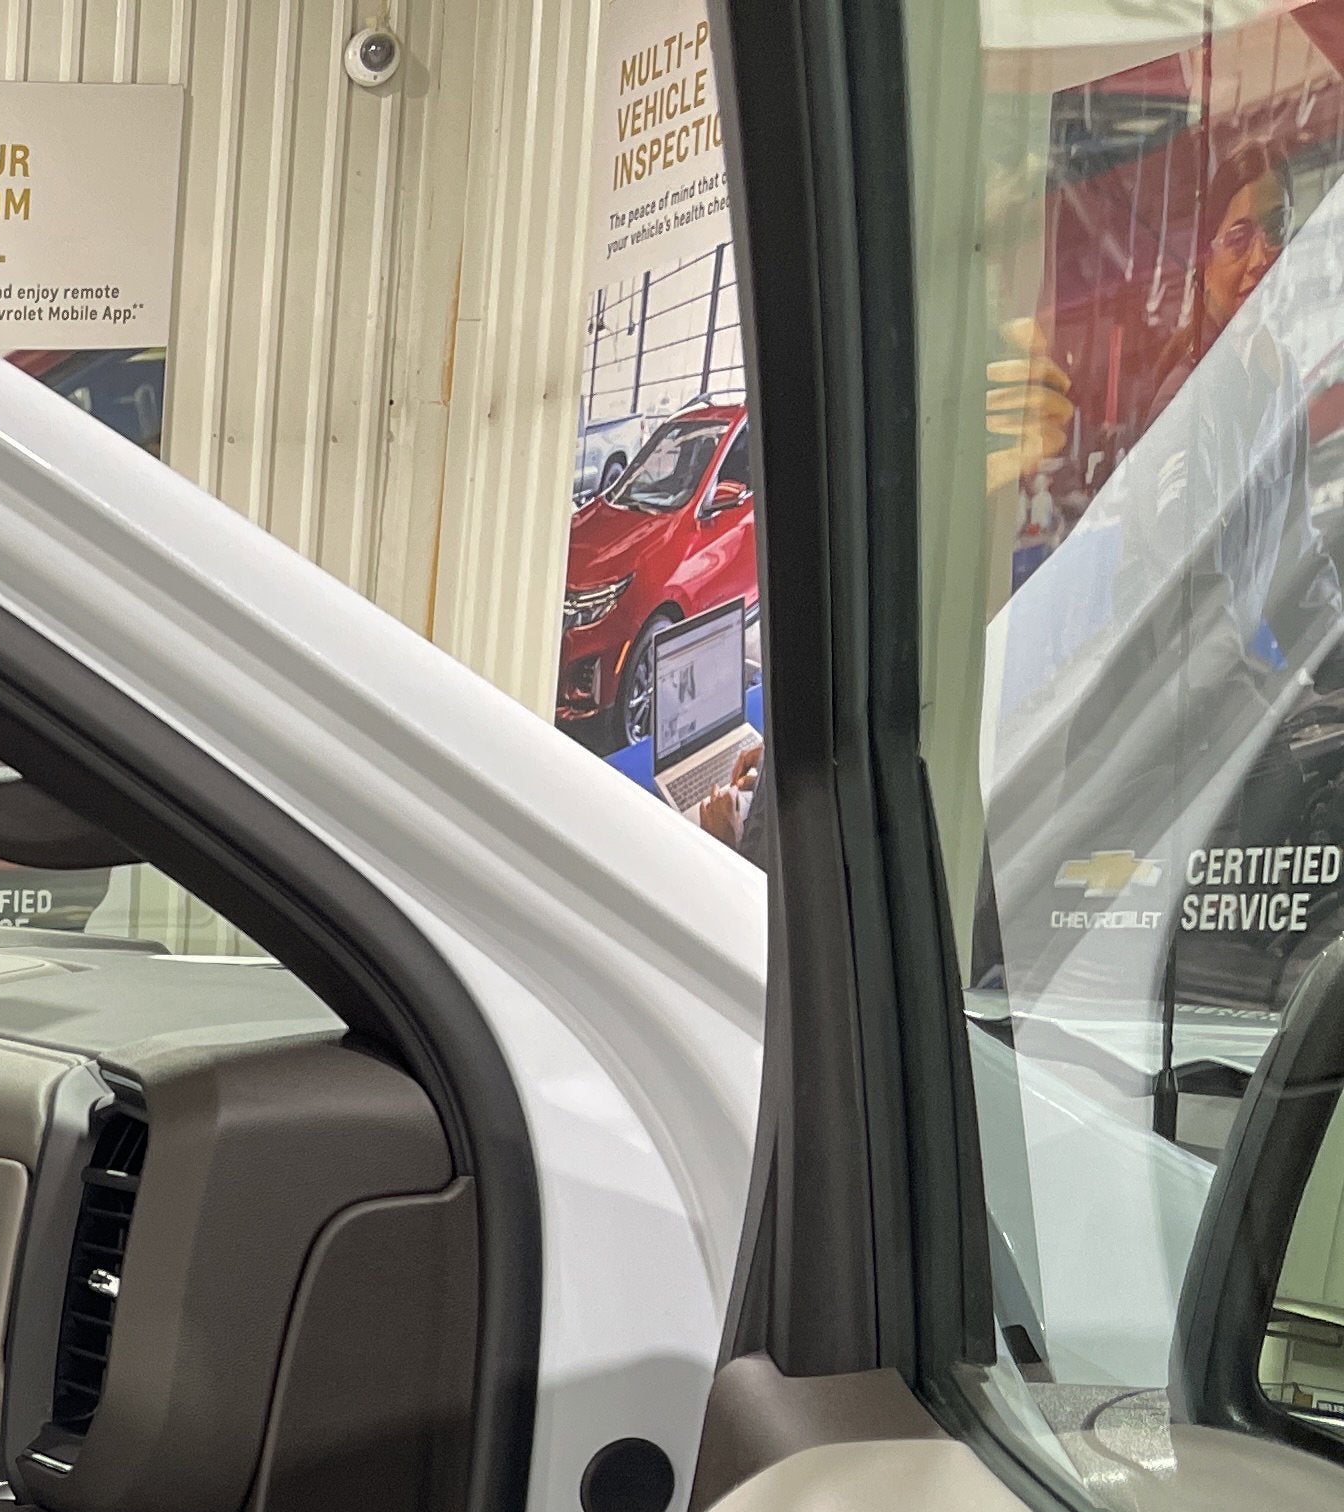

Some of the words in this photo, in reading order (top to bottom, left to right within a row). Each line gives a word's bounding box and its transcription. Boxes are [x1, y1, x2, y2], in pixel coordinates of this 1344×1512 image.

[619, 20, 709, 96] MULTI-P
[617, 68, 708, 143] VEHICLE
[609, 213, 626, 231] The
[628, 200, 656, 228] peace
[658, 190, 669, 210] of
[671, 180, 696, 206] mind
[698, 173, 719, 195] that
[673, 201, 705, 229] health
[17, 284, 59, 303] enjoy
[63, 284, 120, 300] remote
[48, 306, 98, 321] Mobile
[1185, 845, 1341, 887] CERTIFIED
[1050, 910, 1162, 929] CHEVROLET
[1180, 892, 1311, 932] SERVICE
